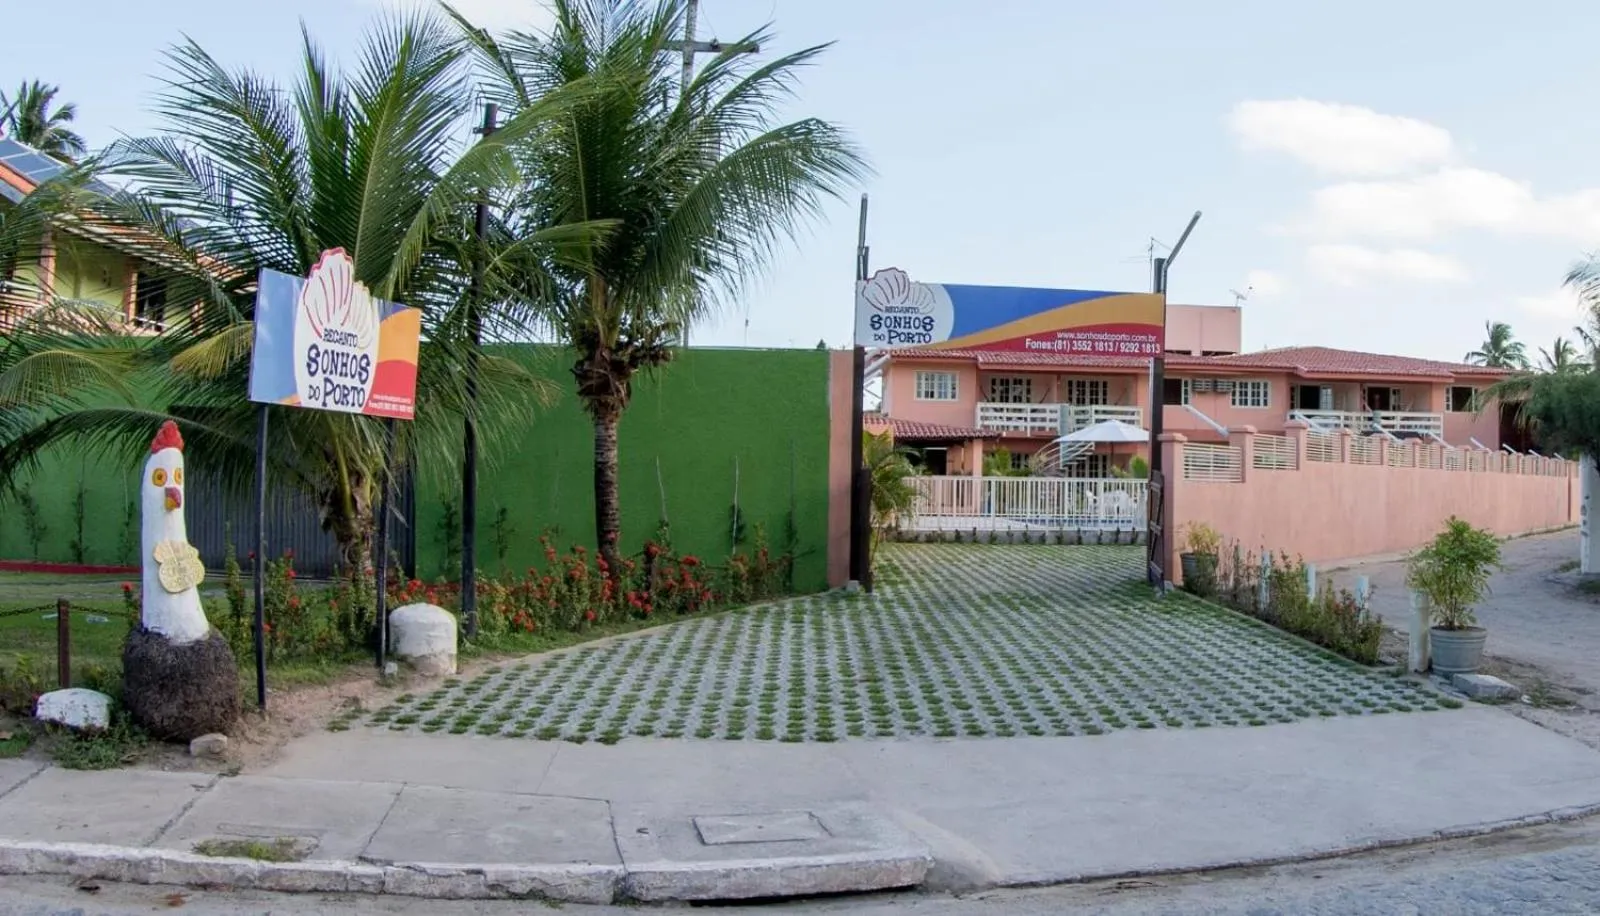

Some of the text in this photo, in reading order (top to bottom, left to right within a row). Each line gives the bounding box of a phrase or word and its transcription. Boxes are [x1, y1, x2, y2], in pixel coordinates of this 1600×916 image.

[885, 306, 920, 314] RECANTO
[870, 314, 934, 332] SONHOS
[323, 328, 358, 347] RECANTO
[887, 329, 932, 344] PORTO
[1072, 340, 1092, 352] 3552
[1094, 341, 1114, 352] 1813
[1120, 342, 1140, 353] 9292
[1142, 343, 1161, 354] 1813
[306, 344, 371, 385] SONHOS
[308, 385, 321, 401] DO
[322, 378, 365, 407] PORTO
